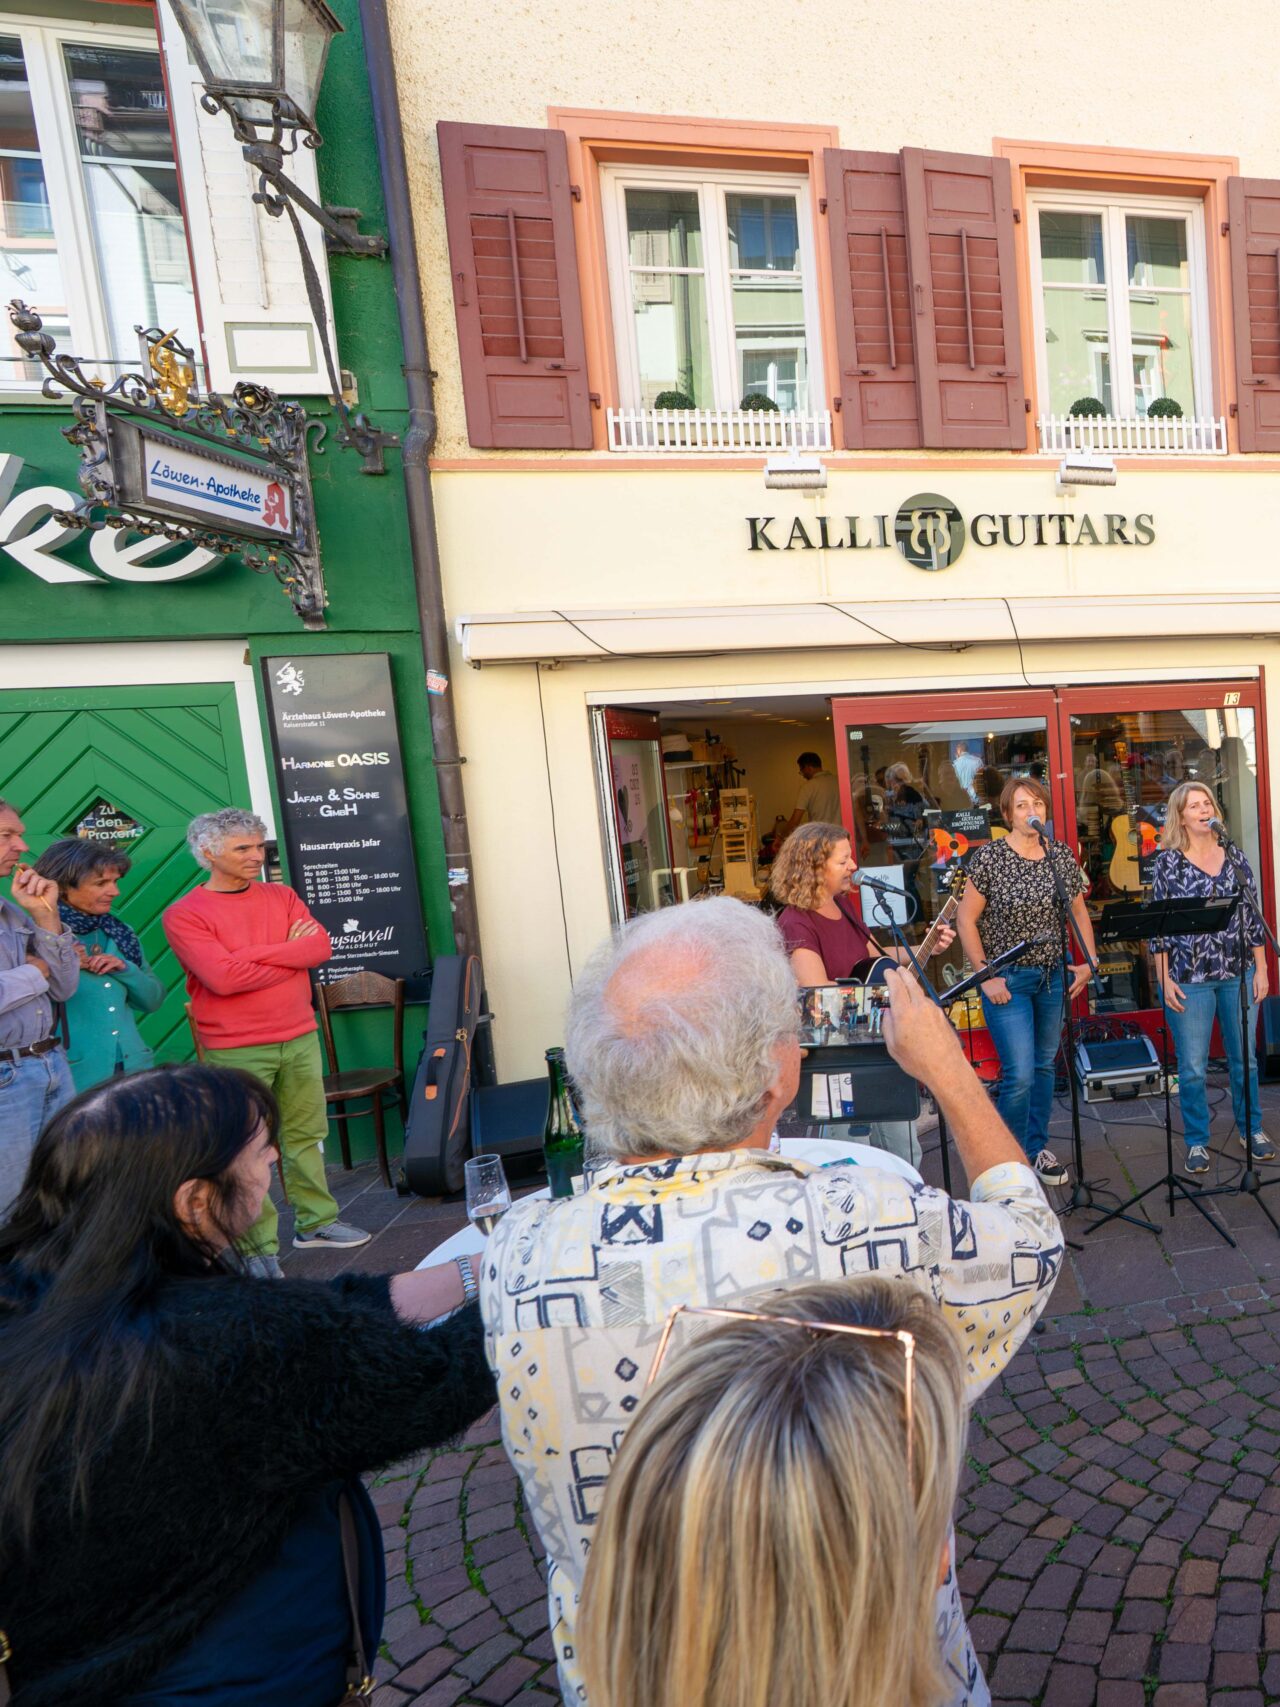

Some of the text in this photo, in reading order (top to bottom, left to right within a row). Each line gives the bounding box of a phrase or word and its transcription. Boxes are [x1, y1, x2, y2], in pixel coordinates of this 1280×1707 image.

[747, 513, 1156, 551] KALLI GUITARS
[1225, 693, 1239, 704] 13
[282, 709, 386, 721] Ärztehaus Löwen-Apotheke
[337, 752, 391, 767] OASIS
[328, 788, 340, 801] &
[99, 805, 115, 815] Zu
[96, 818, 122, 827] den
[300, 838, 381, 851] Hausarztpraxis Jafar
